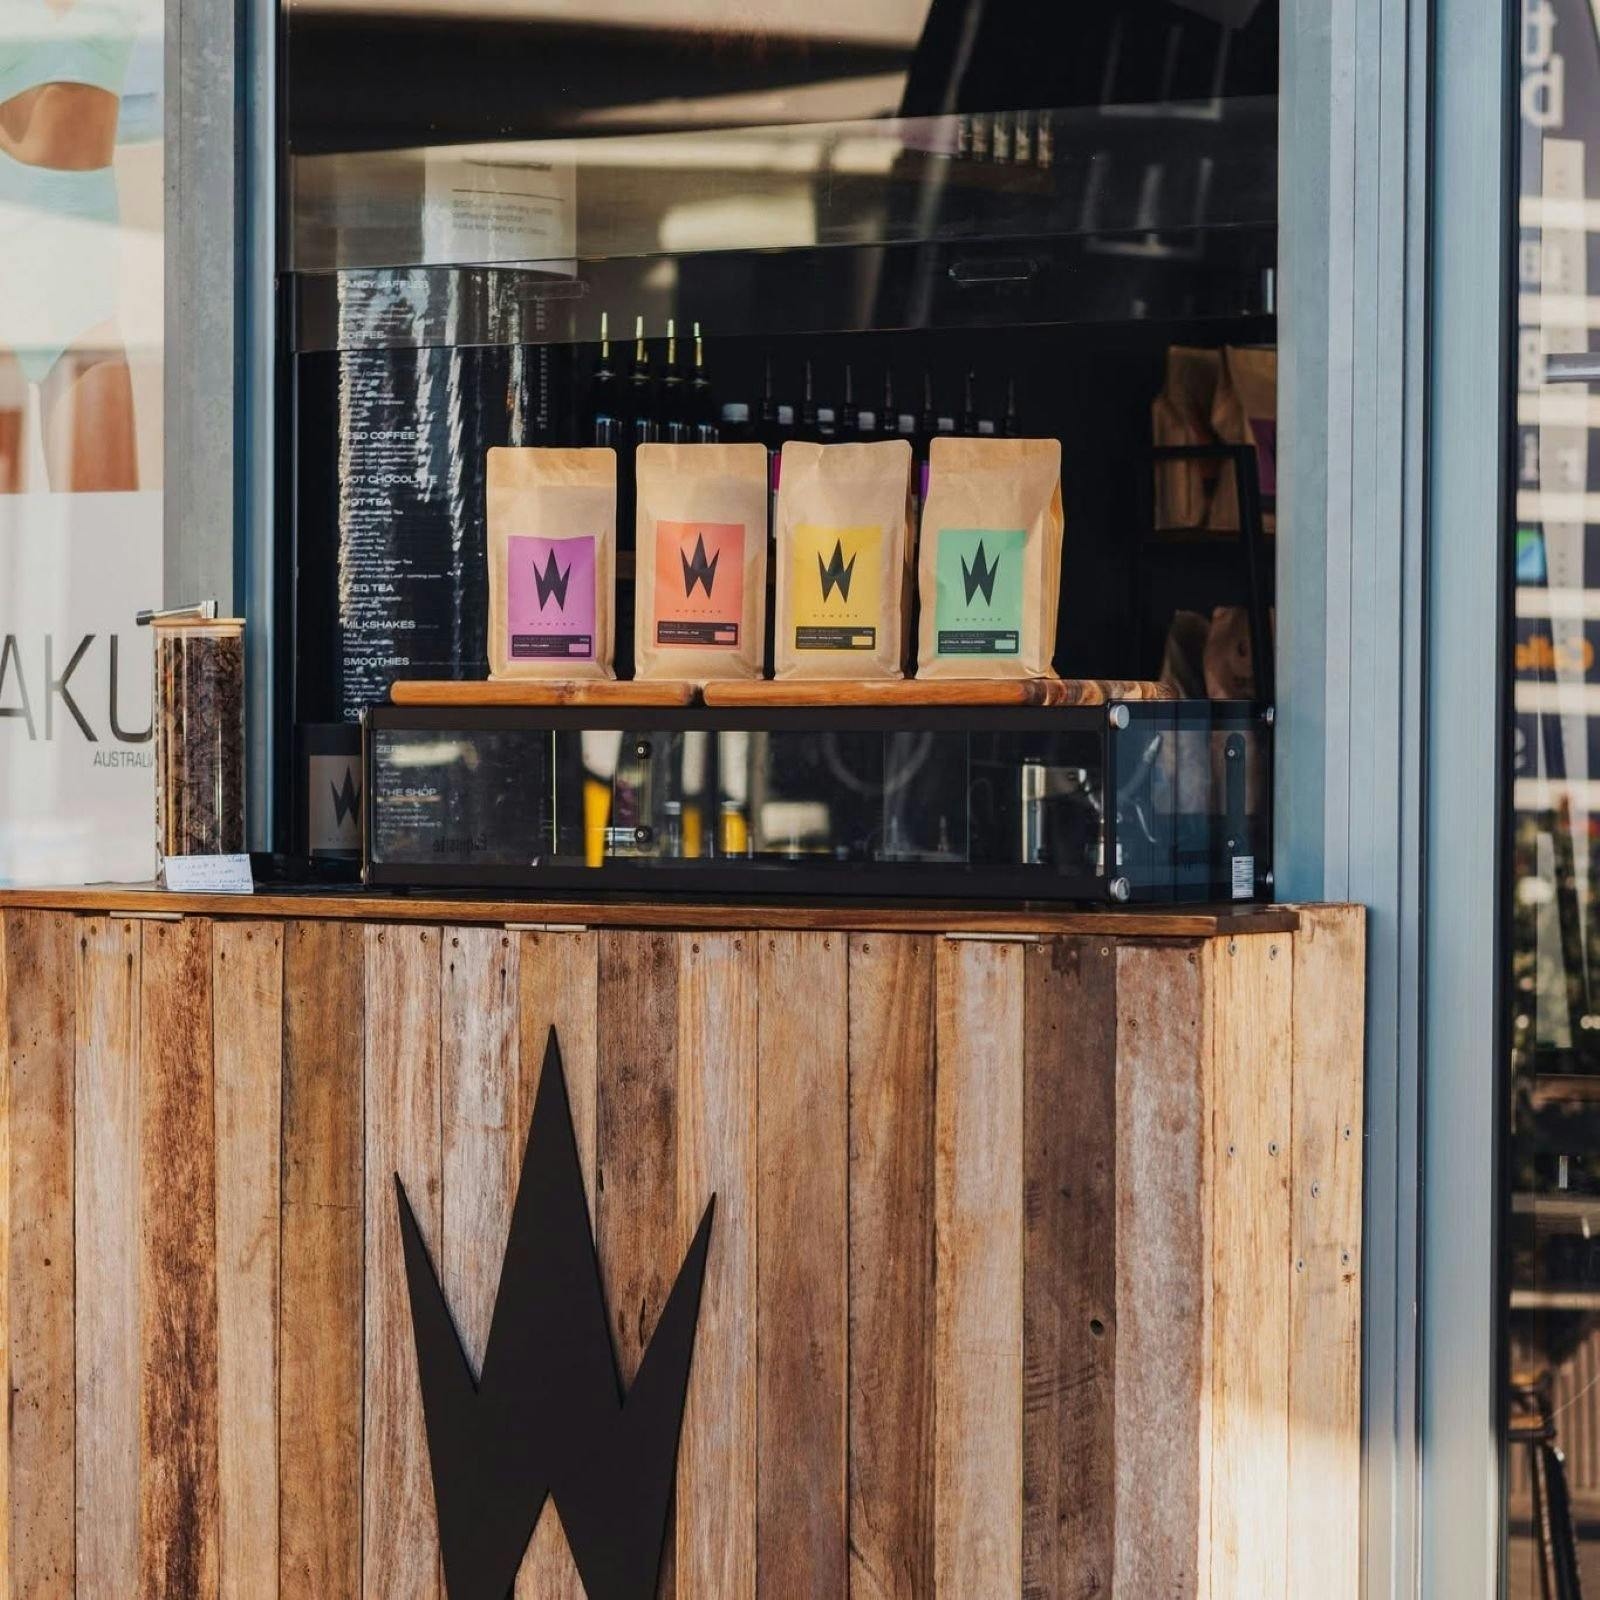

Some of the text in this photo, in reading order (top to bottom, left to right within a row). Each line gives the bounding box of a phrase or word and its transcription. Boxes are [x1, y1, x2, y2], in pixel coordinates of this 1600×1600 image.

[370, 431, 416, 440] COFFEE
[369, 498, 392, 507] TEA
[371, 584, 394, 593] TEA
[343, 620, 416, 629] MILKSHAKES
[343, 656, 410, 666] SMOOTHIES
[405, 787, 437, 797] SHOP
